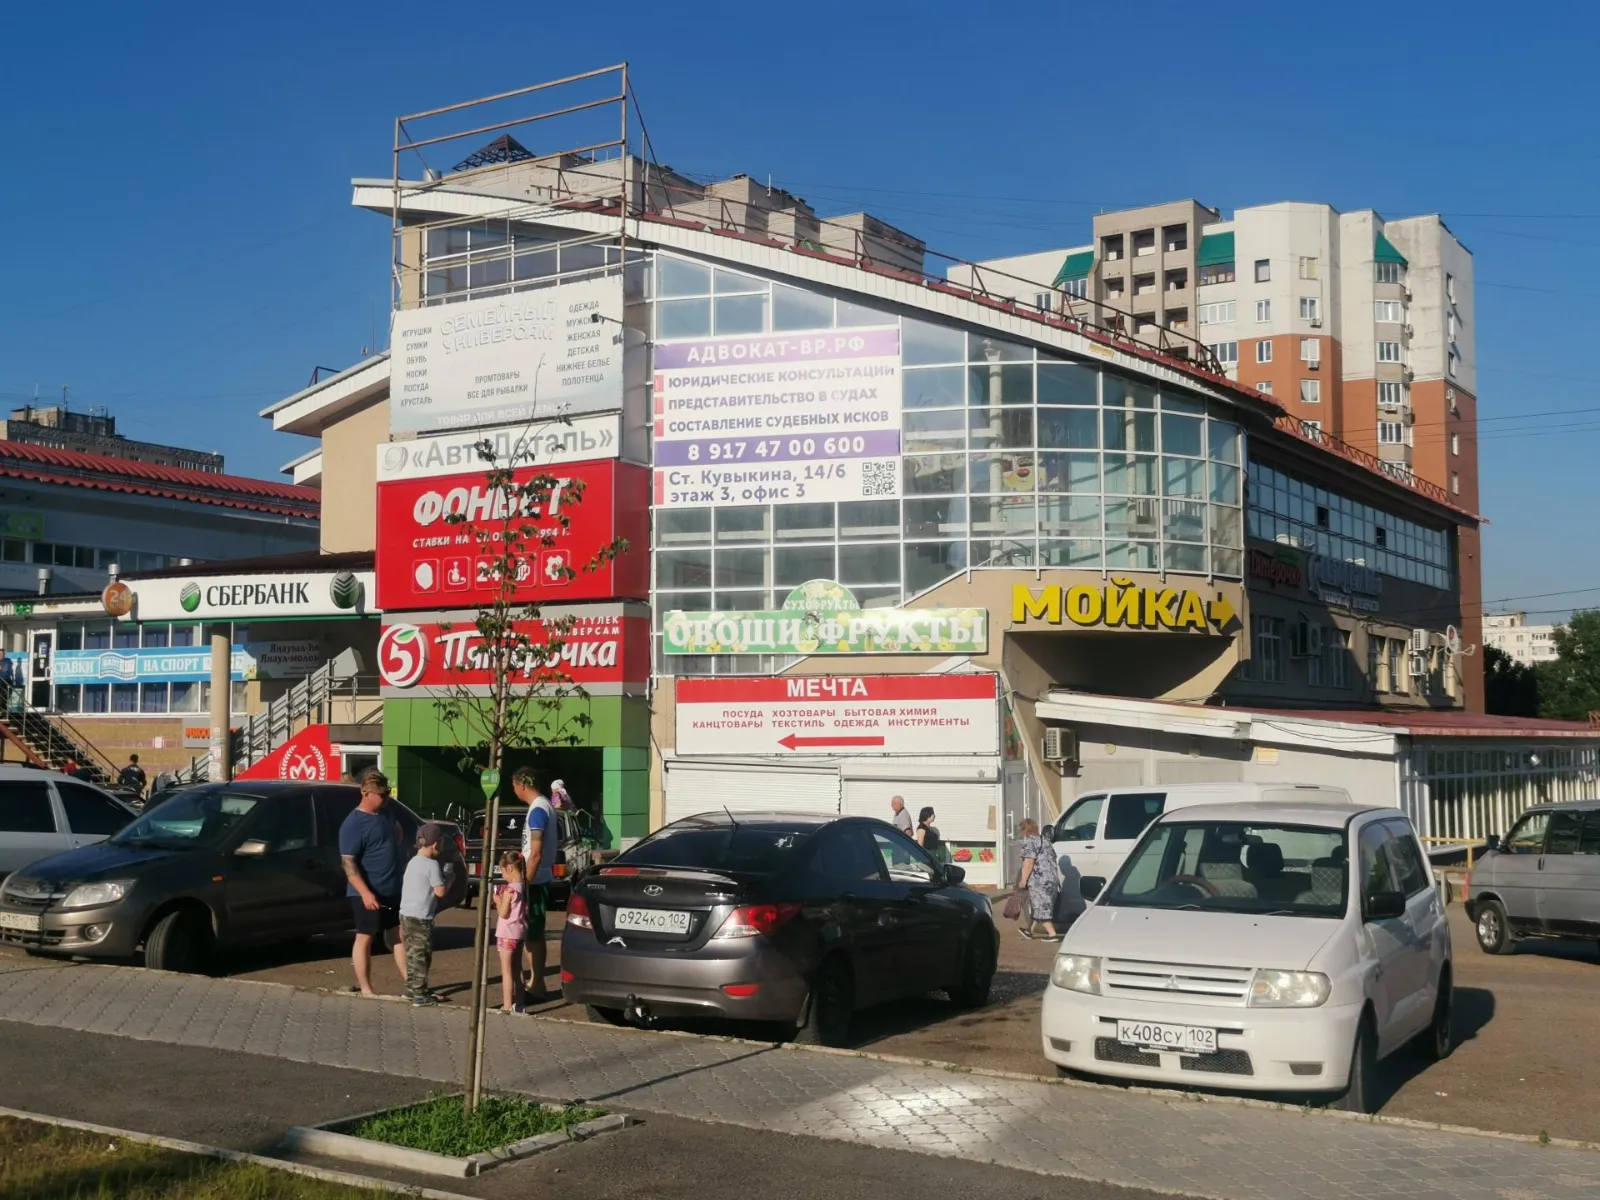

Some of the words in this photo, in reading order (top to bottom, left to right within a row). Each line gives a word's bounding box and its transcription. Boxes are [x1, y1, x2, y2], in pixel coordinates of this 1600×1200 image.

[569, 300, 600, 314] ОДЕЖДА
[440, 301, 557, 336] СЕМЕЙНЫЙ
[566, 314, 600, 328] МУЖСК
[402, 326, 432, 338] ИГРУШКИ
[442, 324, 554, 354] УНИВЕРСАМ
[566, 329, 601, 342] ЖЕНСКАЯ
[406, 341, 428, 351] СУМКИ
[567, 344, 600, 358] ДЕТСКАЯ
[687, 336, 865, 363] АДВОКАТ-ВР.РФ
[406, 355, 427, 365] ОБУВЬ
[556, 360, 586, 373] НИЖНЕЕ
[587, 357, 611, 369] БЕЛЬЕ
[406, 368, 428, 379] НОСКИ
[475, 370, 520, 384] ПРОМТОВАРЫ
[562, 373, 604, 387] ПОЛОТЕНЦА
[668, 372, 774, 388] ЮРИДИЧЕСКИЕ
[778, 366, 894, 382] КОНСУЛЬТАЦИИ
[404, 382, 429, 393] ПОСУДА
[467, 390, 479, 399] ВСЕ
[481, 387, 494, 399] ДЛЯ
[495, 384, 528, 397] РЫБАЛКИ
[401, 396, 432, 407] ХРУСТАЛЬ
[668, 392, 815, 410] ПРЕДСТАВИТЕЛЬСТВО
[819, 391, 827, 402] В
[830, 388, 878, 402] СУДАХ
[437, 414, 470, 426] ТОВАР
[497, 406, 526, 419] ВСЕЙ
[669, 417, 762, 432] СОСТАВЛЕНИЕ
[766, 412, 839, 428] СУДЕБНЫХ
[843, 411, 889, 424] ИСКОВ
[411, 429, 614, 468] «АвтДеталь»
[688, 444, 700, 460] 8
[709, 441, 747, 460] 917
[755, 440, 781, 457] 47
[789, 438, 816, 455] 00
[824, 436, 865, 454] 600
[669, 471, 695, 486] Ст.
[701, 465, 798, 487] Кувыкина,
[804, 464, 846, 480] 14/6
[670, 487, 714, 502] этаж
[720, 486, 735, 502] 3,
[742, 485, 789, 502] офис
[796, 484, 805, 497] 3
[413, 535, 450, 548] СТАВКИ
[455, 532, 470, 545] НА
[206, 582, 310, 607] СБЕРБАНК
[784, 599, 859, 610] СУХОФРУКТЫ
[1012, 577, 1206, 628] МОЙКА
[549, 626, 620, 637] НВЕРСАМ
[667, 617, 802, 648] ОВОЩИ
[818, 616, 985, 646] ФРУКТЫ
[54, 661, 94, 674] СТАВКИ
[144, 659, 159, 671] НА
[161, 657, 200, 671] СПОРТ
[787, 678, 868, 698] МЕЧТА
[722, 709, 764, 718] ПОСУДА
[772, 708, 836, 718] ХОЗТОВАРЫ
[844, 708, 896, 717] БЫТОВАЯ
[899, 707, 937, 716] ХИМИЯ
[692, 720, 763, 730] КАНЦТОВАРЫ
[771, 719, 825, 728] ТЕКСТИЛЬ
[833, 718, 880, 728] ОДЕЖДА
[888, 718, 970, 727] ИНСТРУМЕНТЫ
[668, 913, 686, 925] 102
[1189, 1029, 1213, 1042] 102
